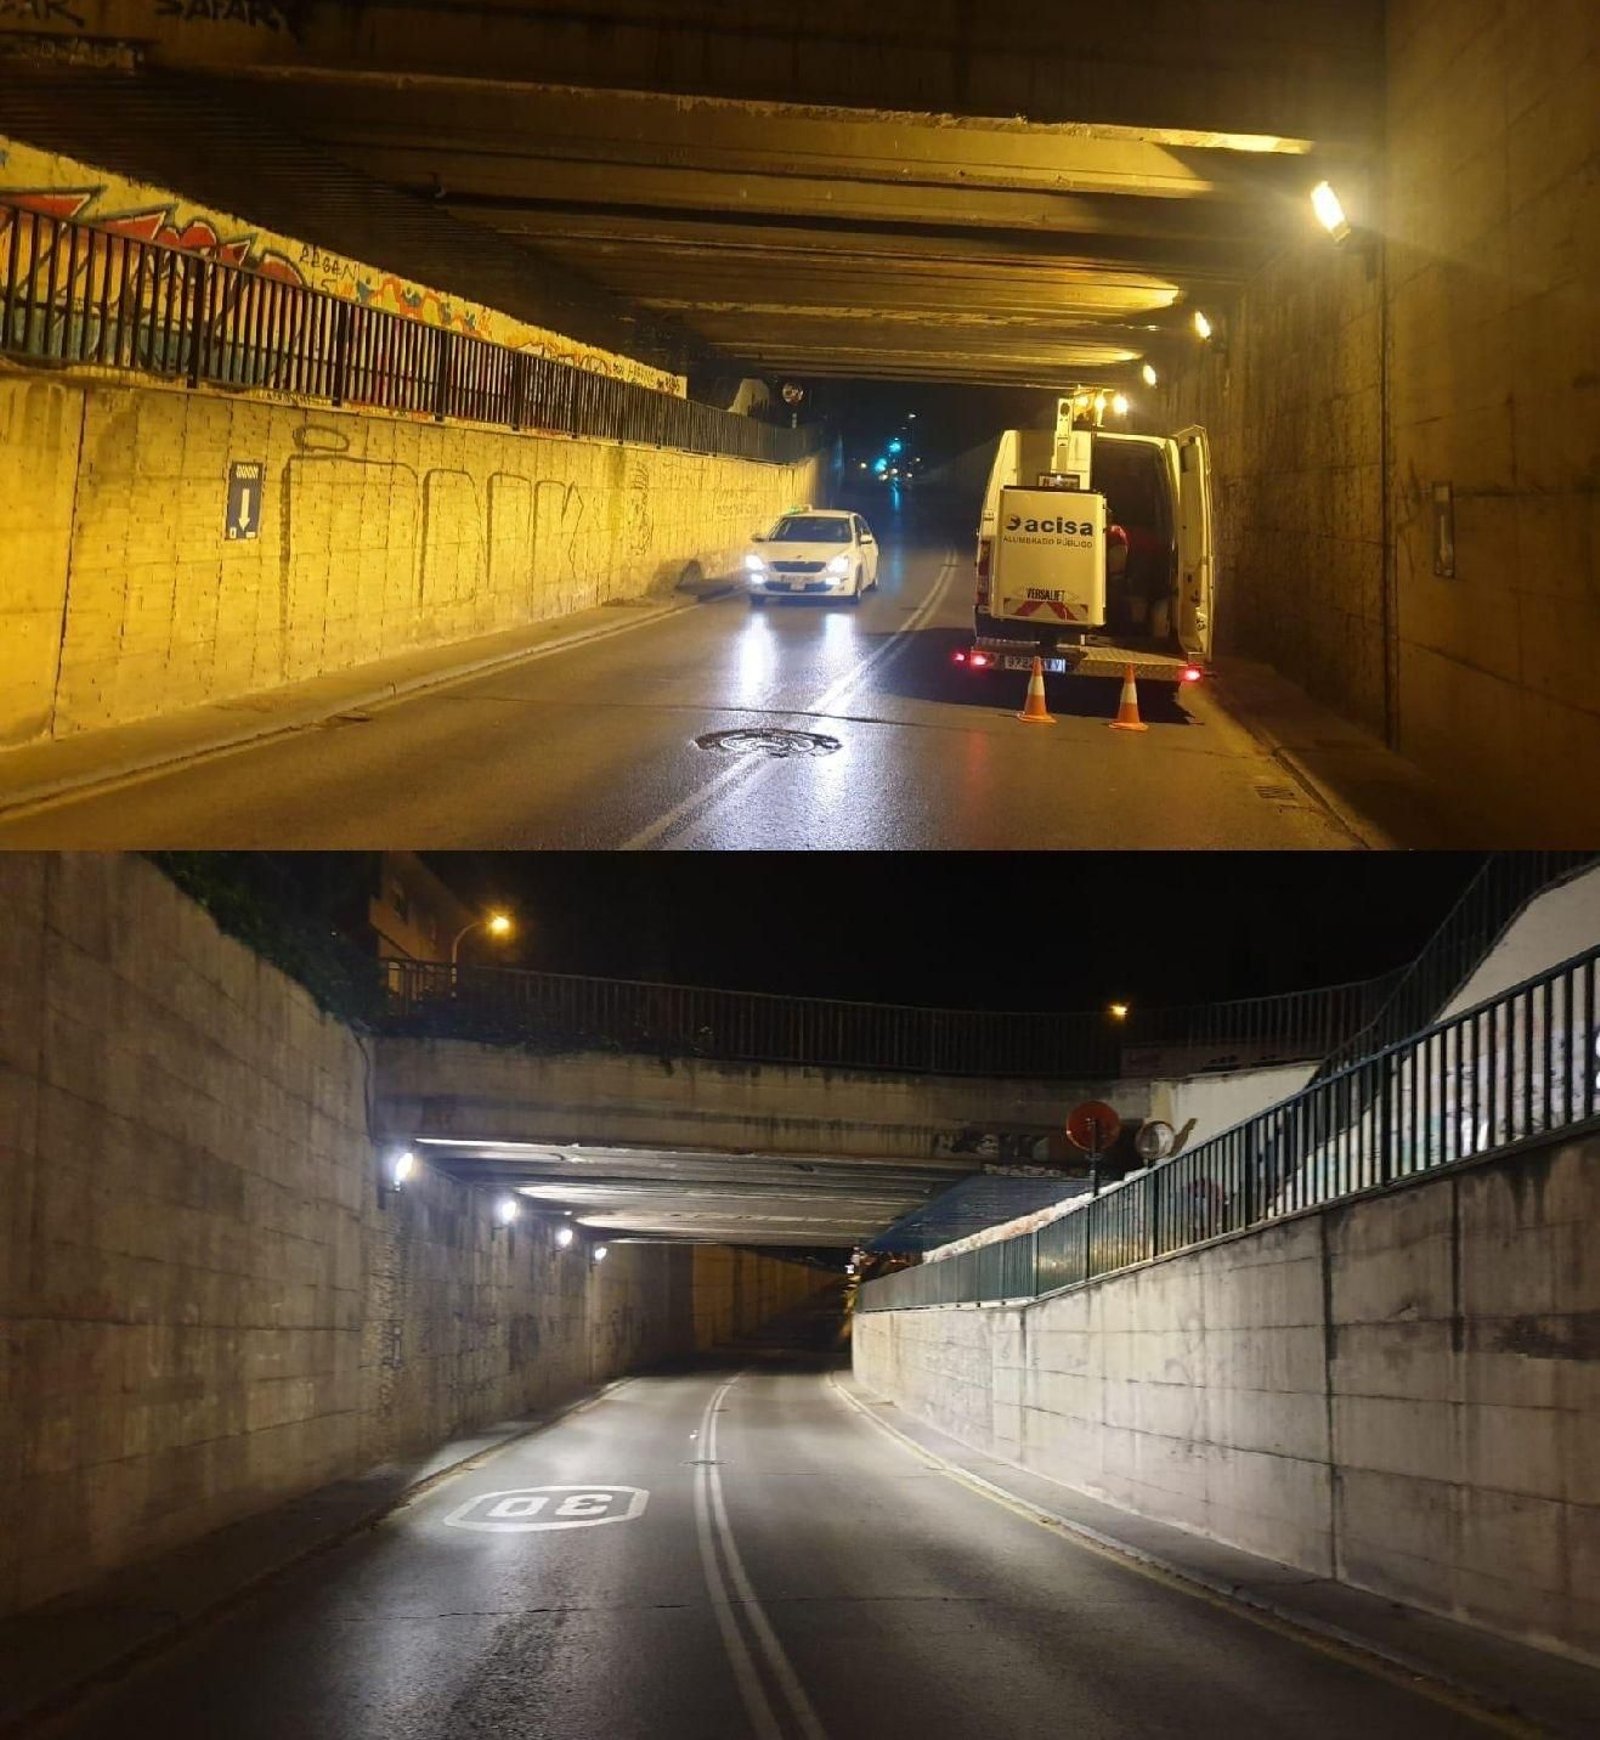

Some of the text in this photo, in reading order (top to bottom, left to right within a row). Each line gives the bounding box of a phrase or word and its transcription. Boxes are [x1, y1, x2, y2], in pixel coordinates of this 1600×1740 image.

[1024, 517, 1093, 536] acisa
[1003, 535, 1054, 546] ALUMBRADO
[1026, 586, 1067, 601] VERSALIFT
[486, 1493, 613, 1518] 30
